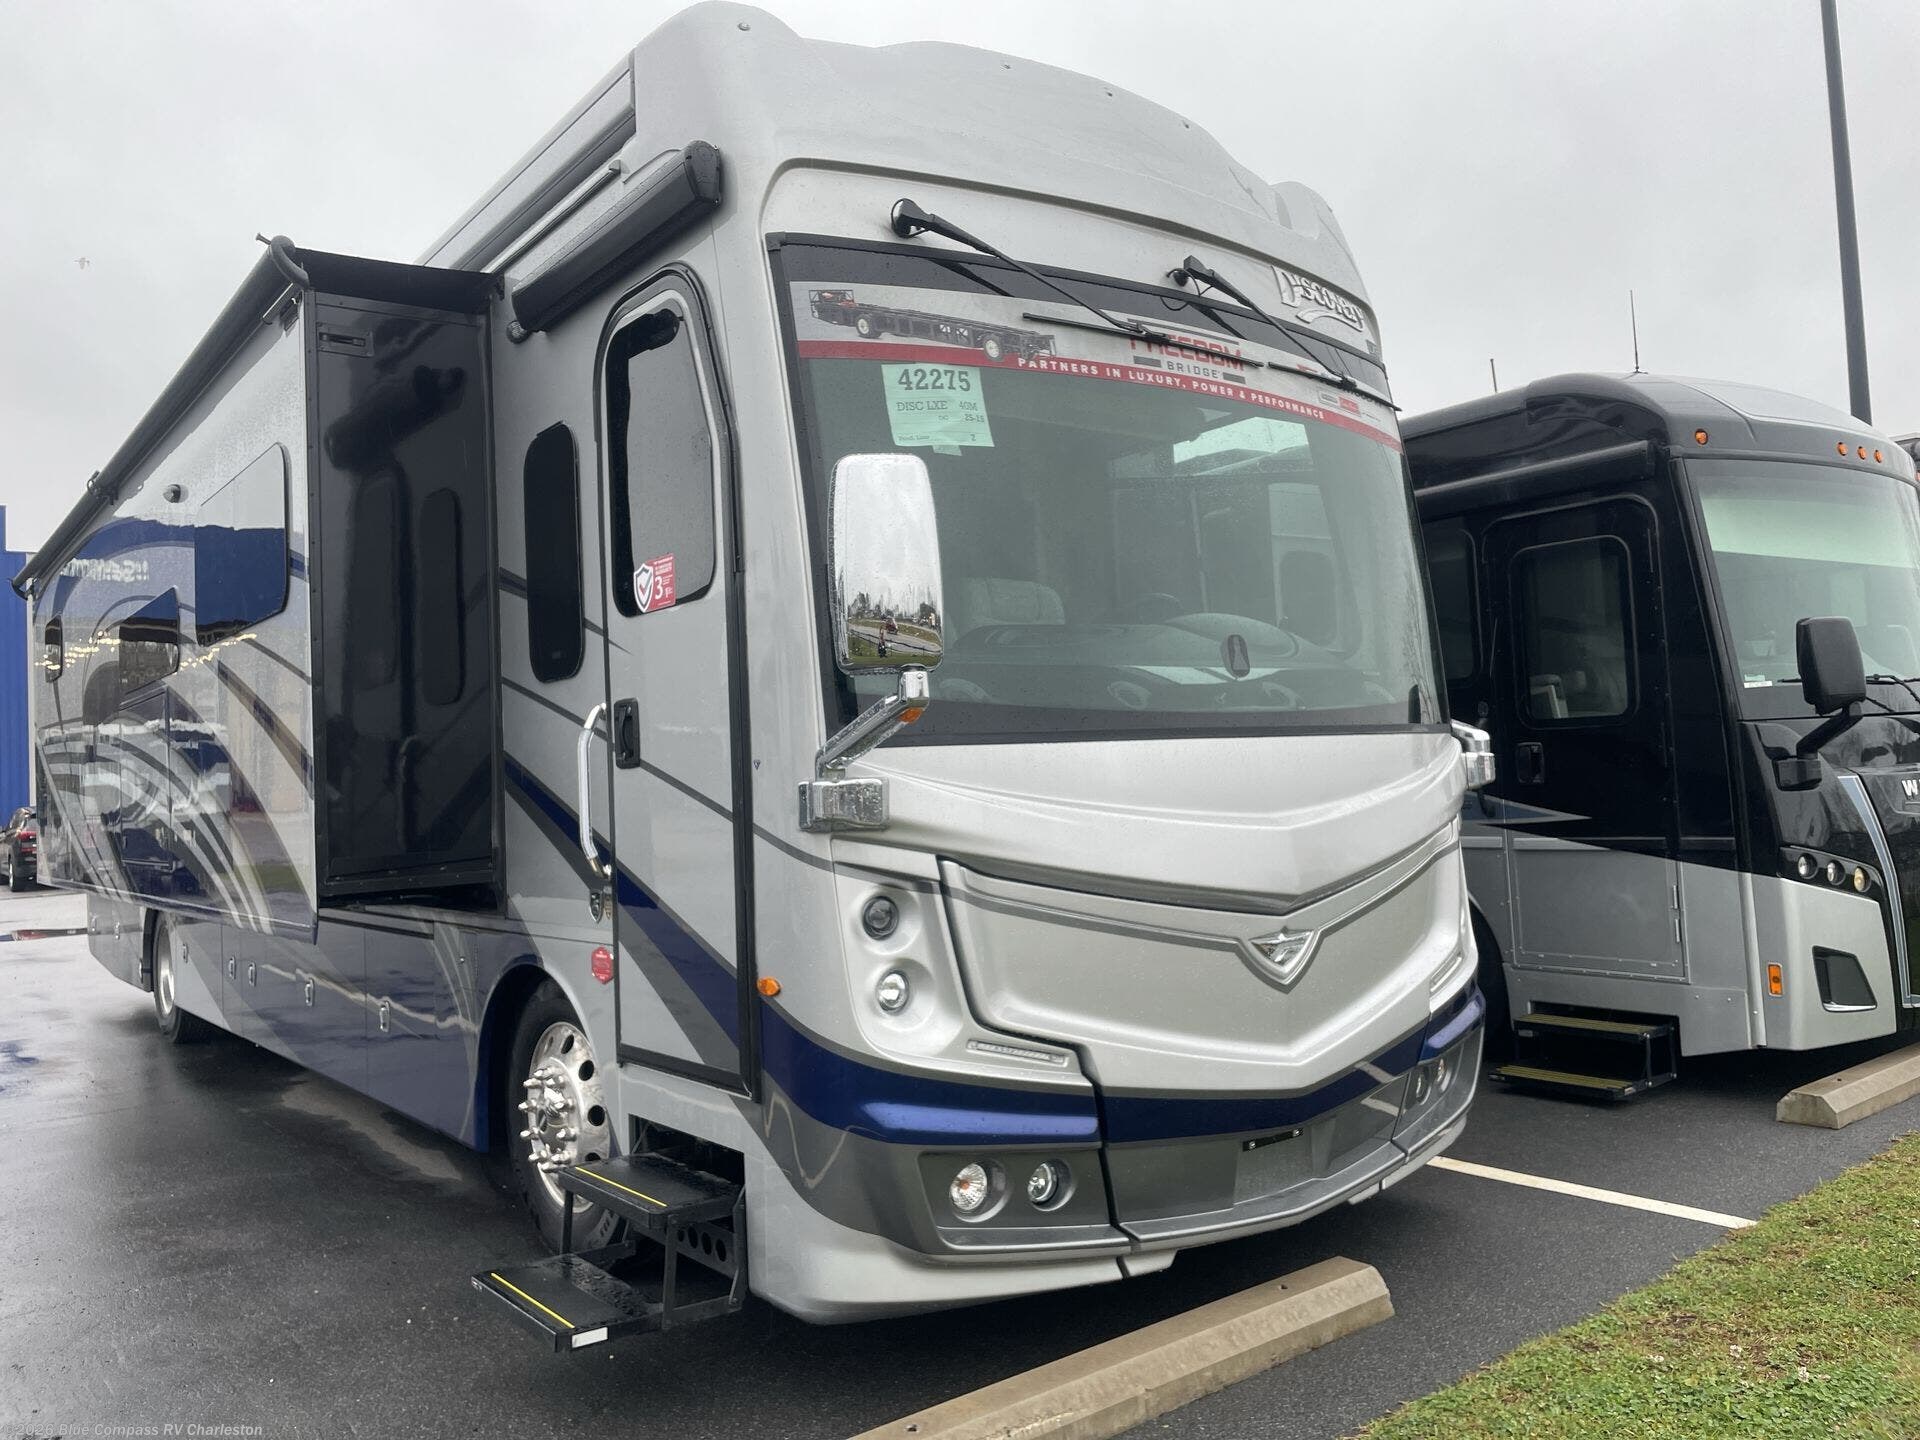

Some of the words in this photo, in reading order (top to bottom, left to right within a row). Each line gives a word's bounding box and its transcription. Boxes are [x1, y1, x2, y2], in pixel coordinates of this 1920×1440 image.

[897, 368, 971, 392] 42275
[1166, 360, 1218, 379] BRIDGE
[1018, 357, 1098, 375] PARTNERS
[1106, 367, 1121, 378] IN
[1128, 370, 1187, 389] LUXURY,
[1192, 380, 1234, 396] POWER
[1239, 389, 1246, 399] &
[1251, 392, 1325, 420] PERFORMANCE
[896, 401, 924, 412] DISC
[926, 400, 948, 411] LXE
[654, 575, 664, 600] 3
